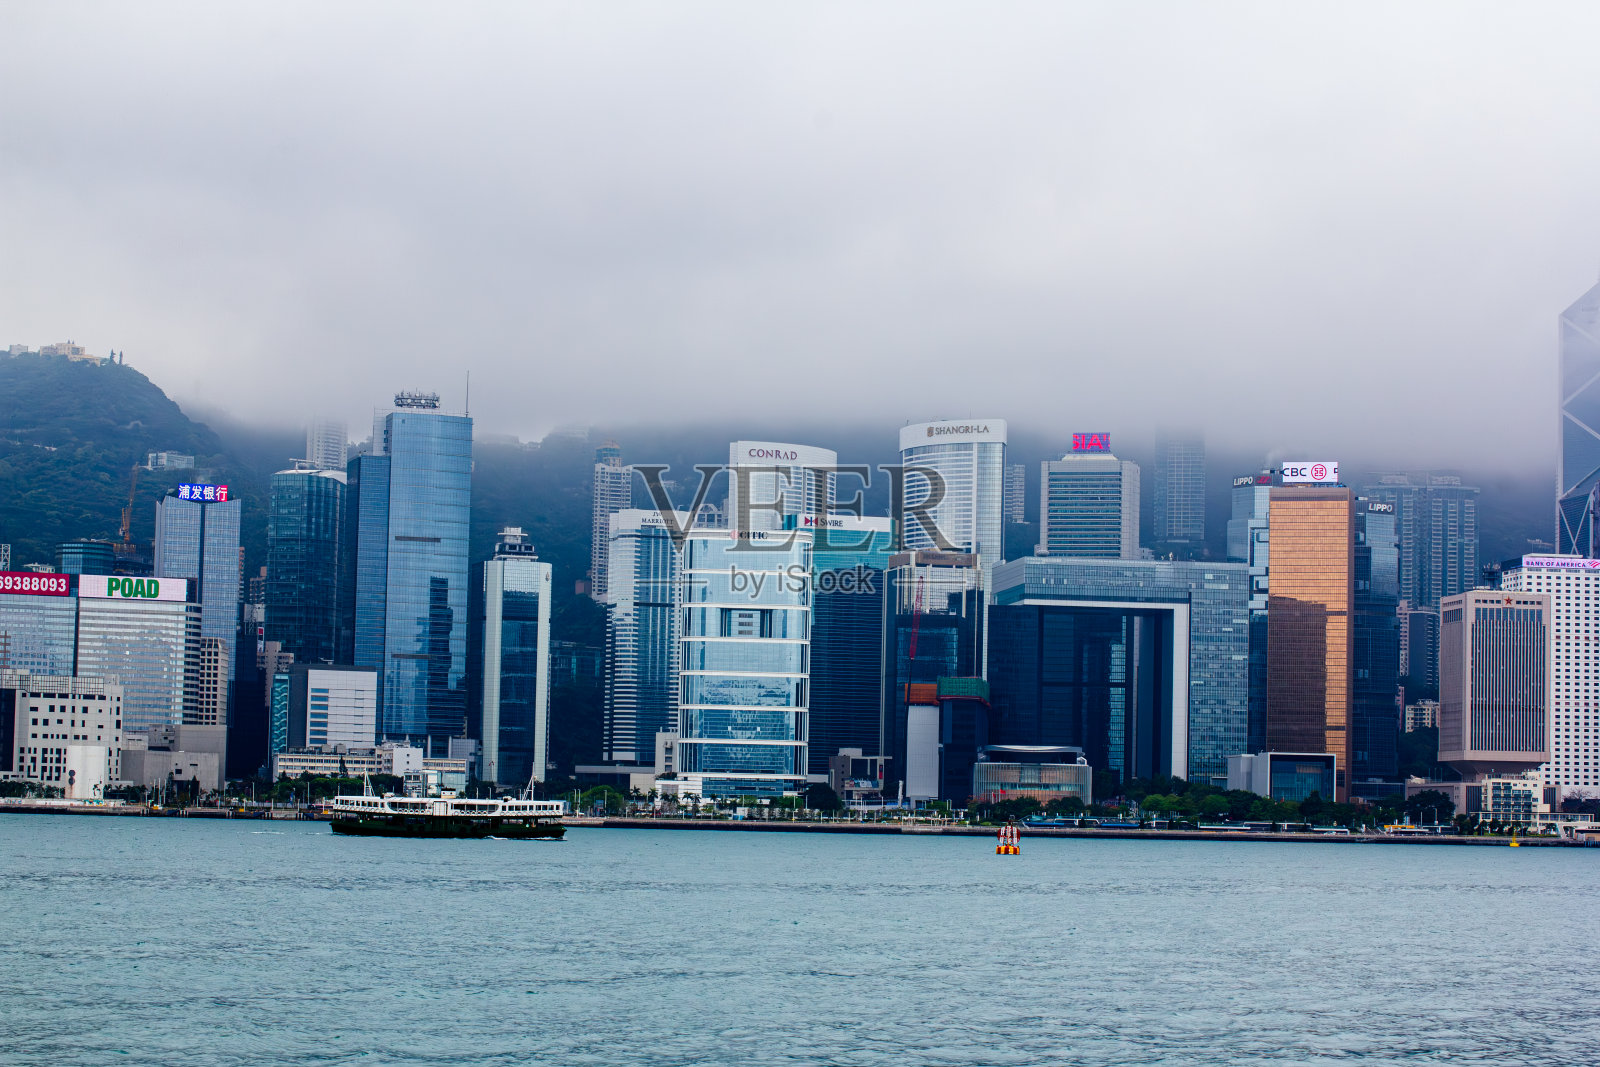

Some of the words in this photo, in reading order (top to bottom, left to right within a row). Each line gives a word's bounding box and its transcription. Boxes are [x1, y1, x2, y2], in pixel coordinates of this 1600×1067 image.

[935, 425, 990, 435] SHANGRI-LA
[1072, 434, 1110, 450] SIA'
[748, 448, 798, 461] CONRAD
[1233, 476, 1254, 486] LIPPO
[178, 484, 228, 501] 浦发银行
[1368, 502, 1393, 512] LIPPO
[739, 531, 769, 540] CITIC
[107, 577, 160, 598] POAD
